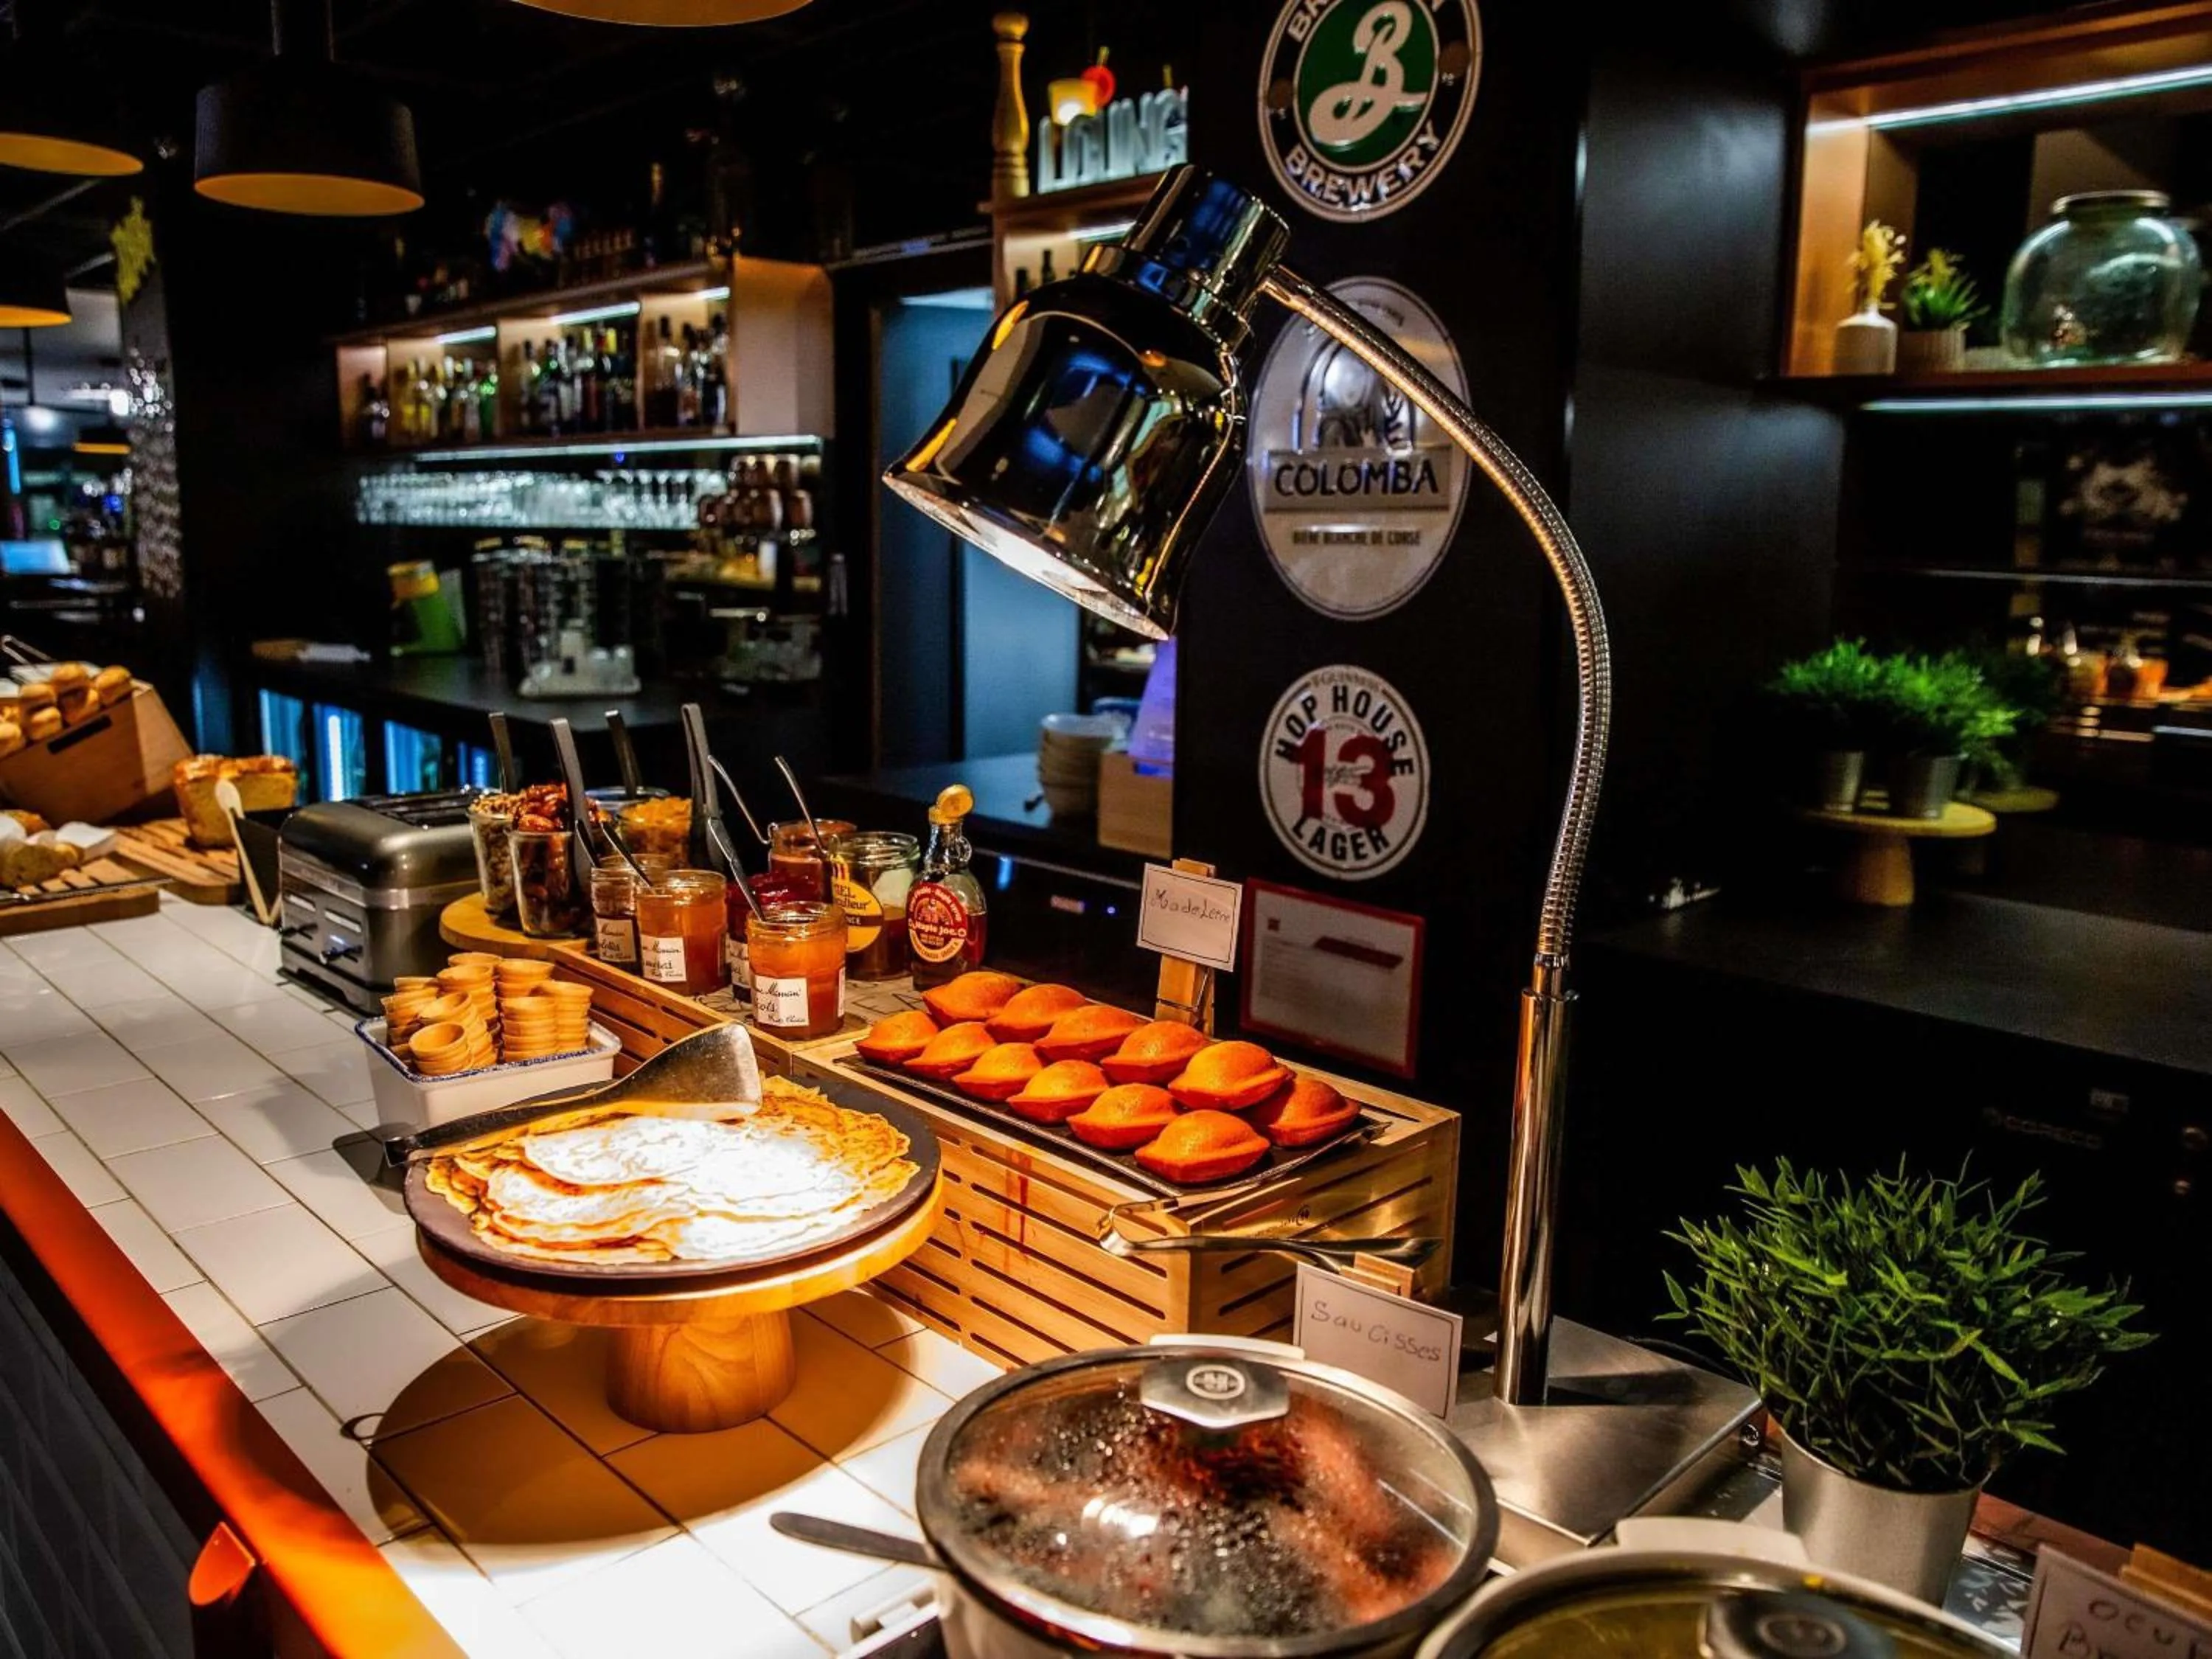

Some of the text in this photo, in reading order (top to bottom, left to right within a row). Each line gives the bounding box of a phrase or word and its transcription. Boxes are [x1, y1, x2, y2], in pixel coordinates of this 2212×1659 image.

[1285, 120, 1441, 205] BREWERY
[1274, 459, 1439, 497] COLOMBA
[1275, 684, 1415, 776] HOP HOUSE
[1295, 727, 1396, 830] 13
[1292, 817, 1391, 862] LAGER
